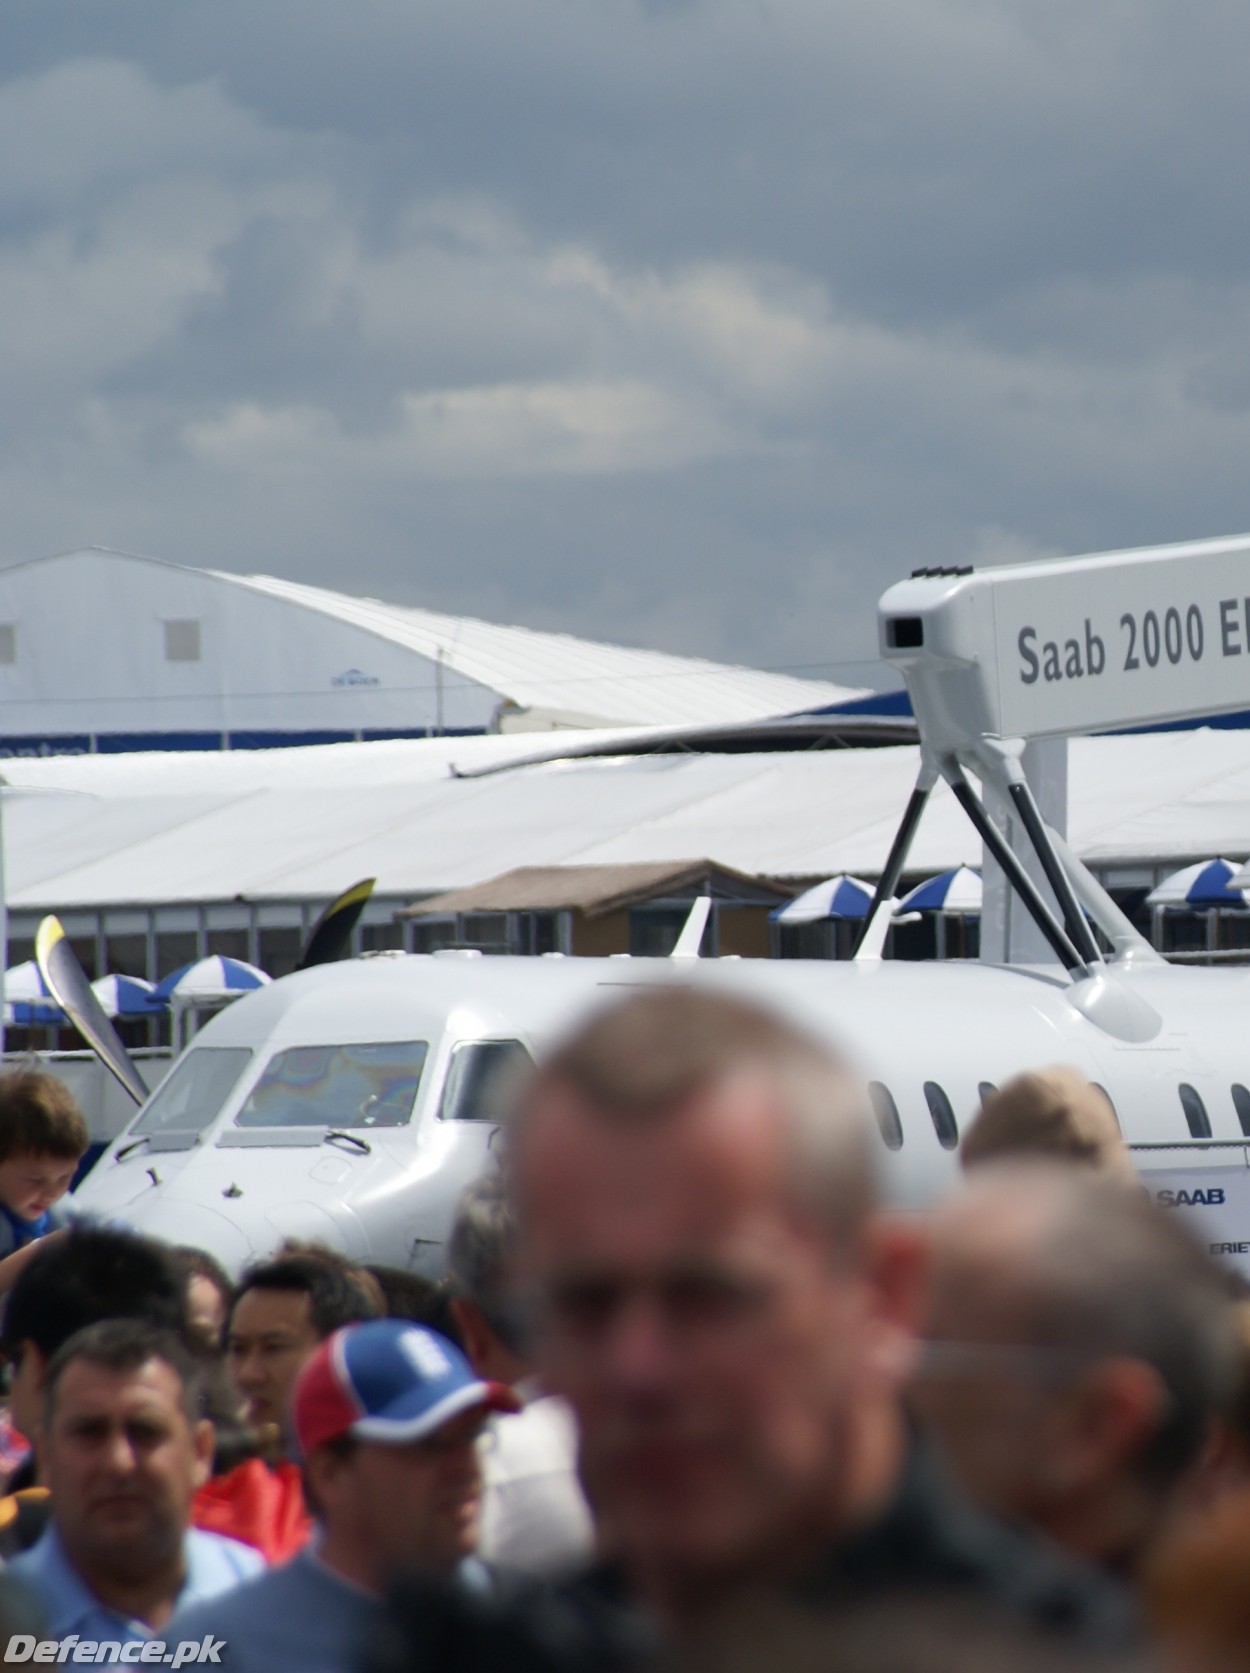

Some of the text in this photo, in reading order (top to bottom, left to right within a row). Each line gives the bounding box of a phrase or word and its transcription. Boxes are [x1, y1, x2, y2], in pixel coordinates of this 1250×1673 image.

[1018, 618, 1105, 684] Saab
[1120, 603, 1204, 671] 2000
[1157, 1188, 1225, 1207] SAAB
